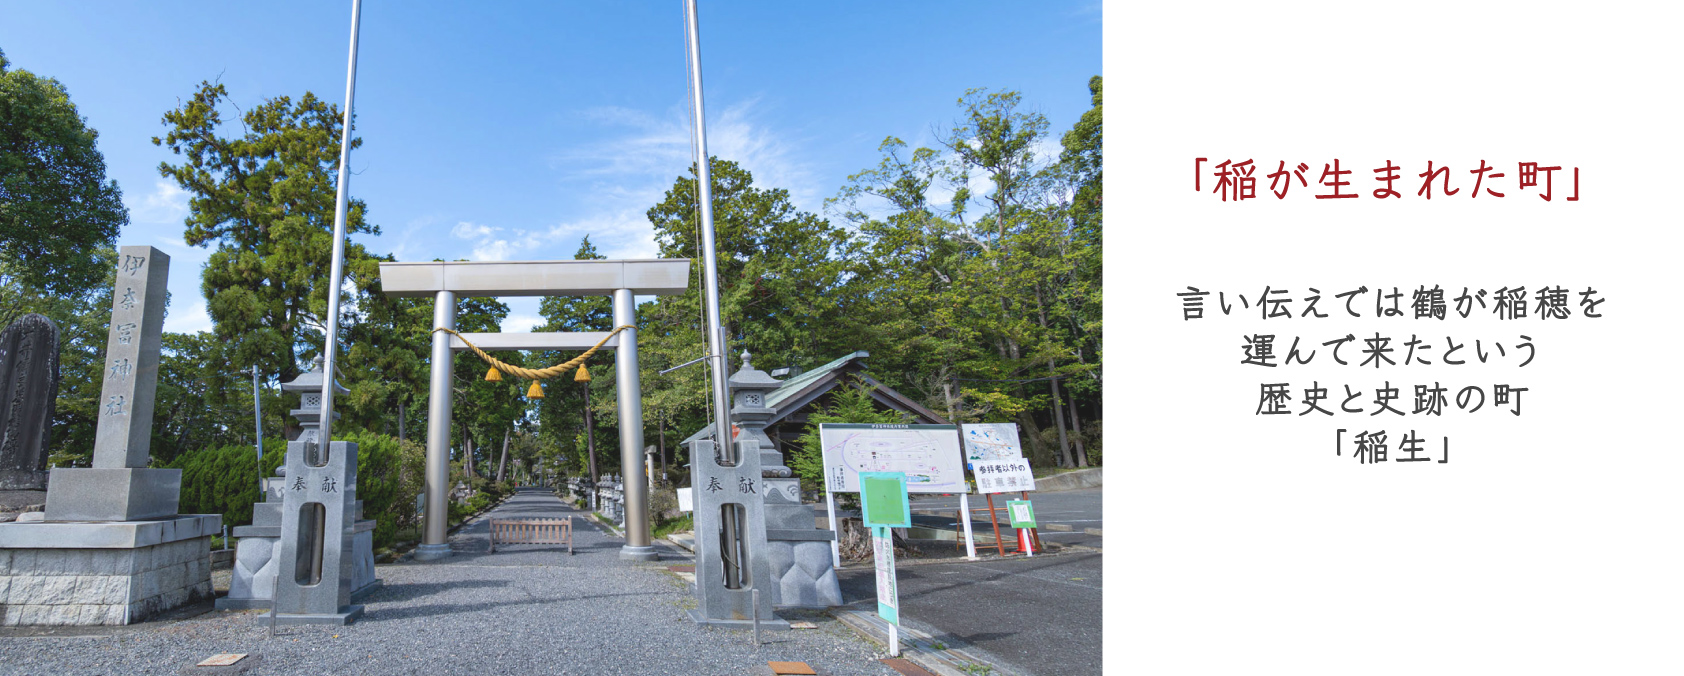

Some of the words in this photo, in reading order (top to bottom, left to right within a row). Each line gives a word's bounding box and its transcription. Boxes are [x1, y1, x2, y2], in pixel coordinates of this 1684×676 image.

[979, 464, 1026, 474] 参拝者以外の
